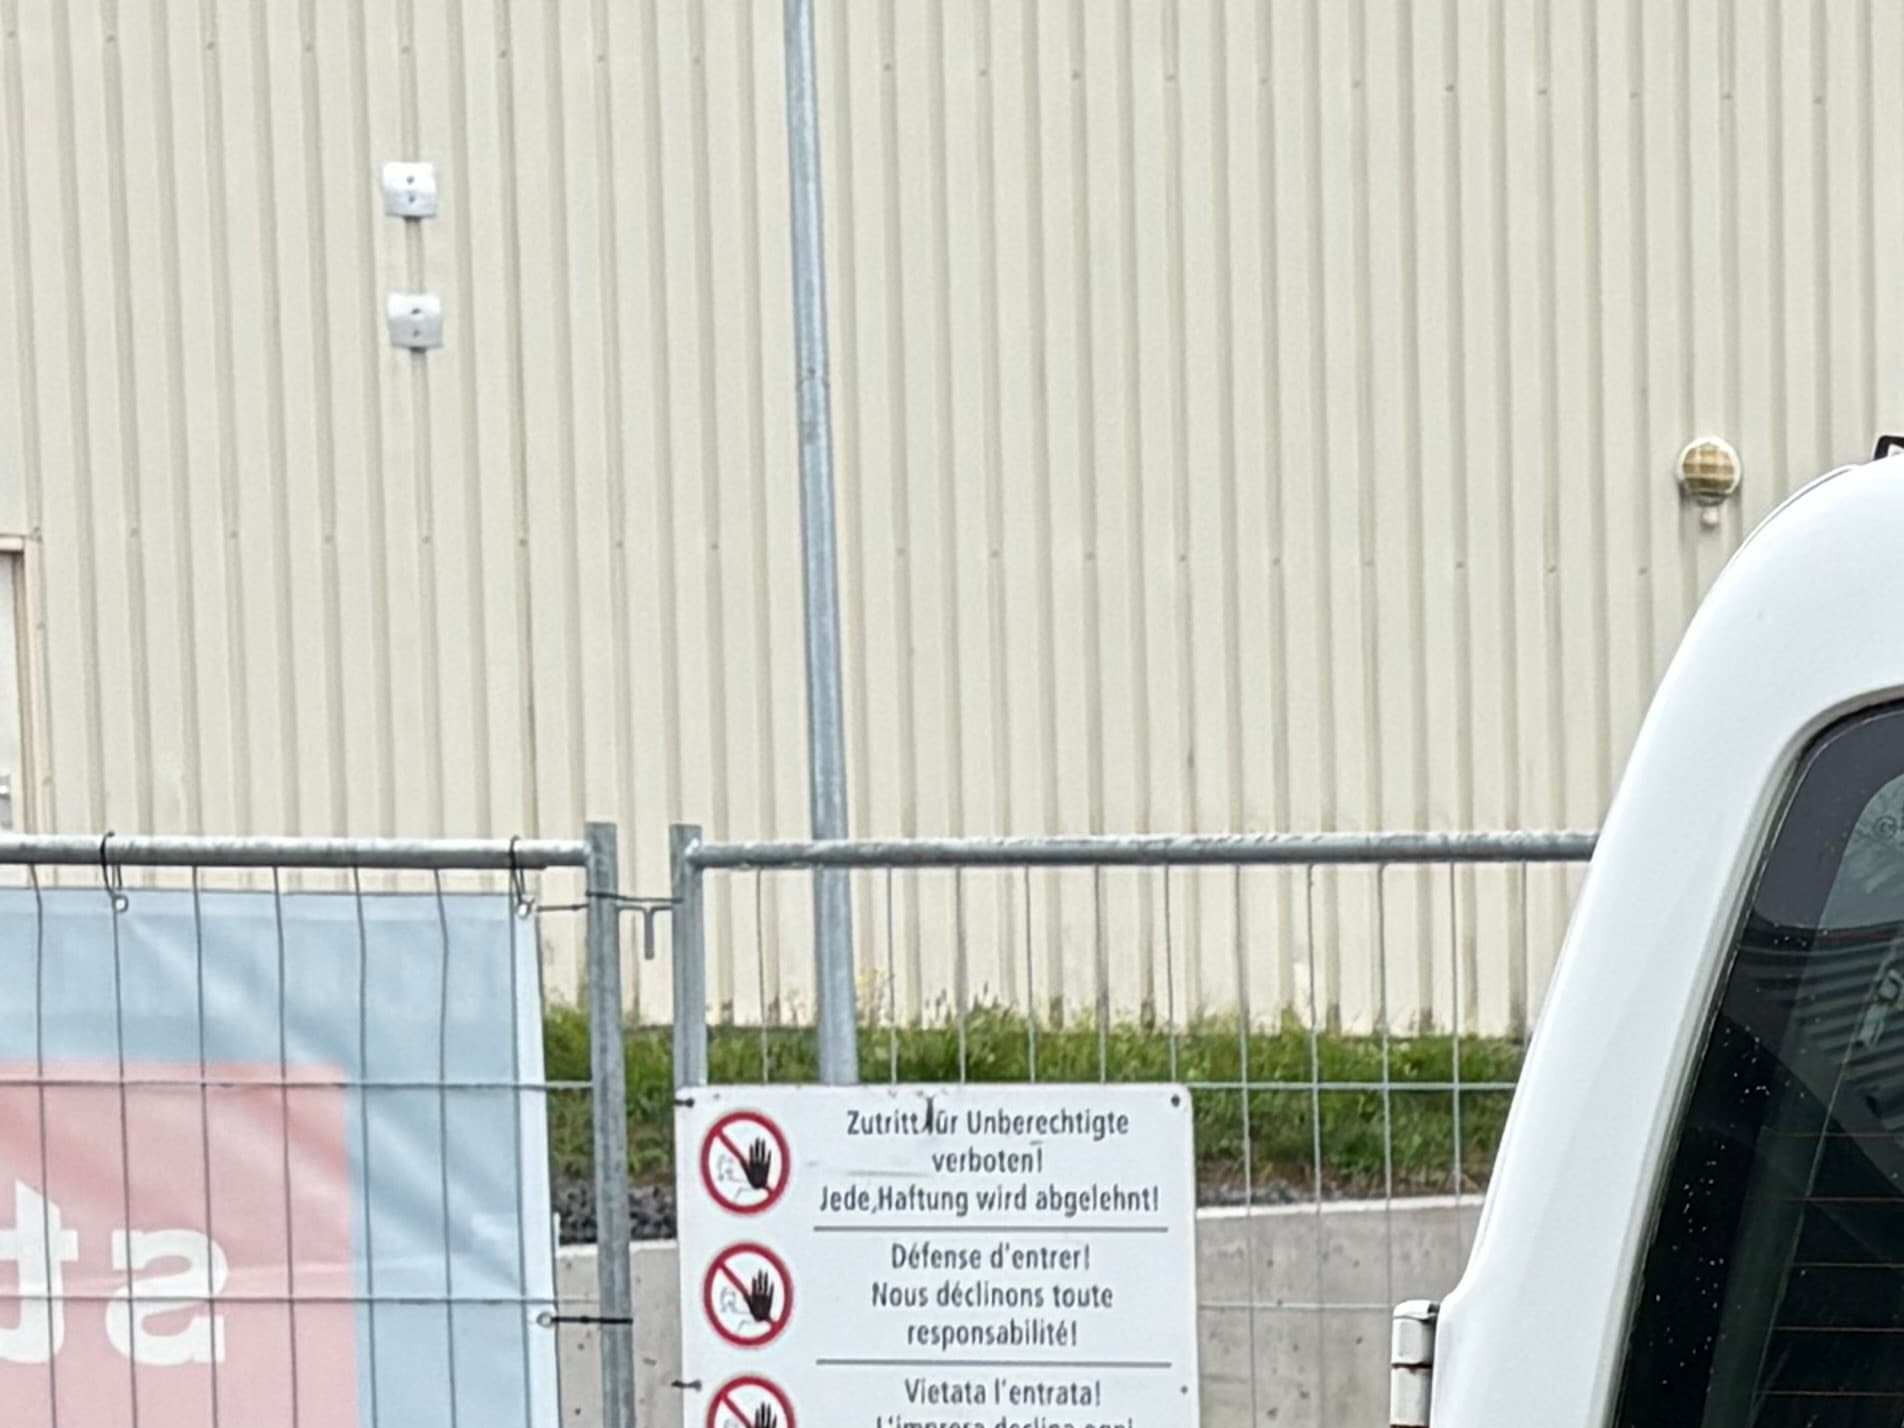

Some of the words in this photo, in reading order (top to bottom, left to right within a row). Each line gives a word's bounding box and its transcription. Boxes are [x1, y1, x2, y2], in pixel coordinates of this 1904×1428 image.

[846, 1108, 920, 1135] Zutritt
[967, 1109, 1129, 1141] Unberechtigte
[931, 1147, 1043, 1174] verboten!
[877, 1185, 969, 1217] Haftung
[976, 1184, 1027, 1212] wird
[1035, 1185, 1159, 1217] abgelehnt!
[891, 1242, 982, 1270] Défense
[990, 1242, 1090, 1271] d'entrer!
[871, 1281, 929, 1308] Nous
[936, 1281, 1044, 1308] déclinons
[1053, 1283, 1113, 1308] toute
[907, 1319, 1077, 1351] responsabilité!
[904, 1378, 986, 1405] Vietata
[994, 1378, 1101, 1406] l'entrata!
